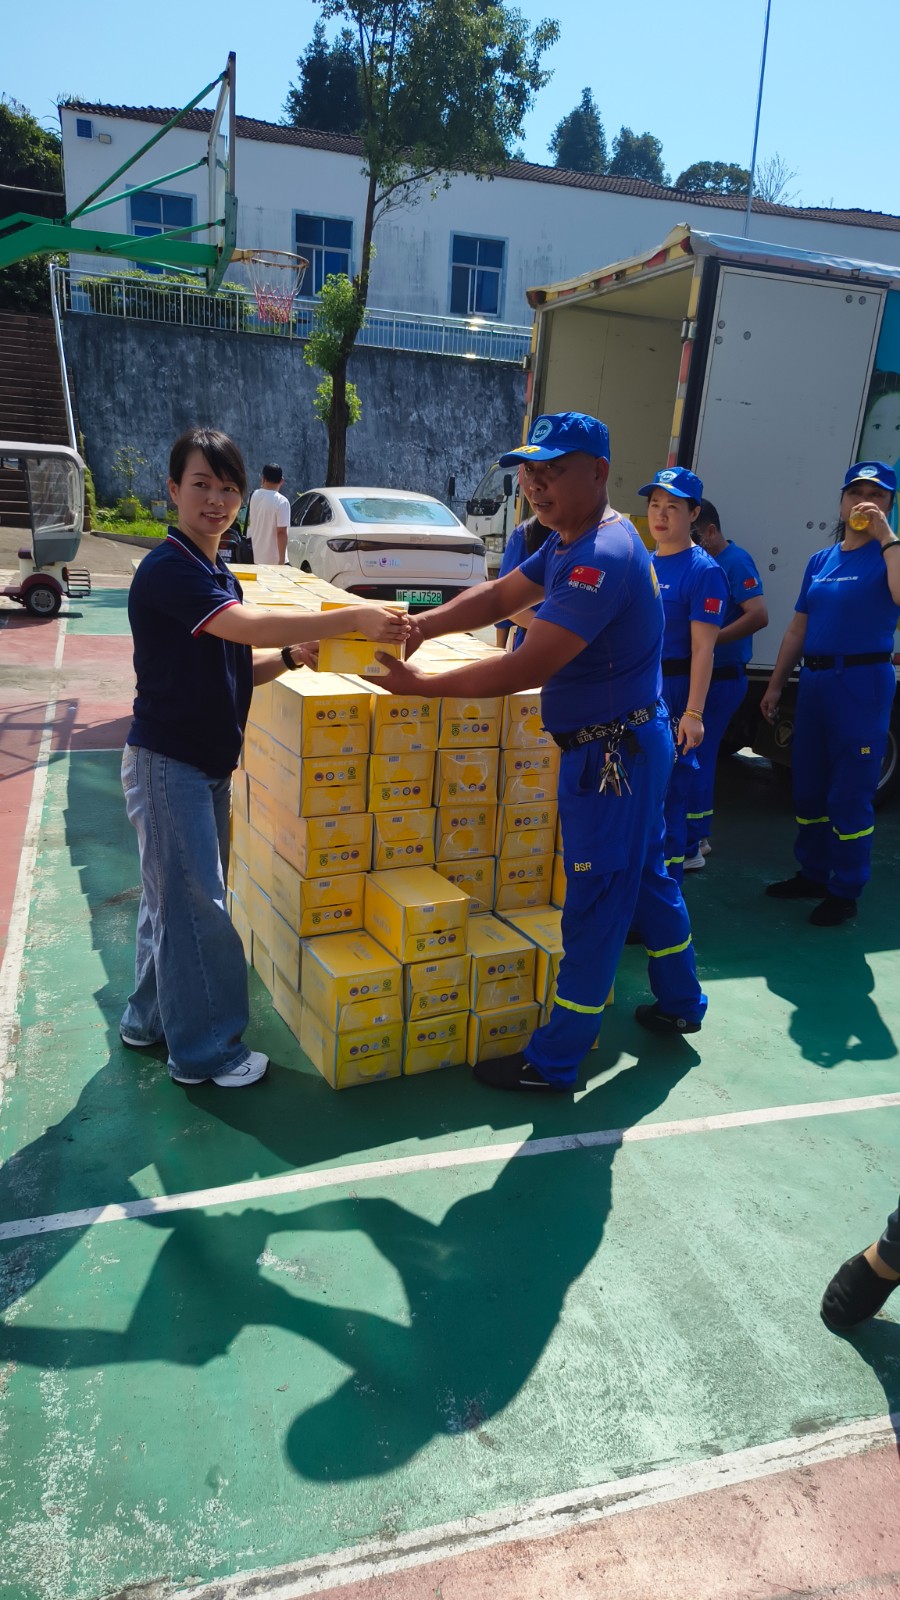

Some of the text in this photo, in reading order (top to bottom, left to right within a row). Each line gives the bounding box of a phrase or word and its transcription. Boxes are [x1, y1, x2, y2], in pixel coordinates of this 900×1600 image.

[580, 582, 598, 594] CHINA
[411, 590, 442, 604] FJ7528
[574, 861, 592, 872] BSR
